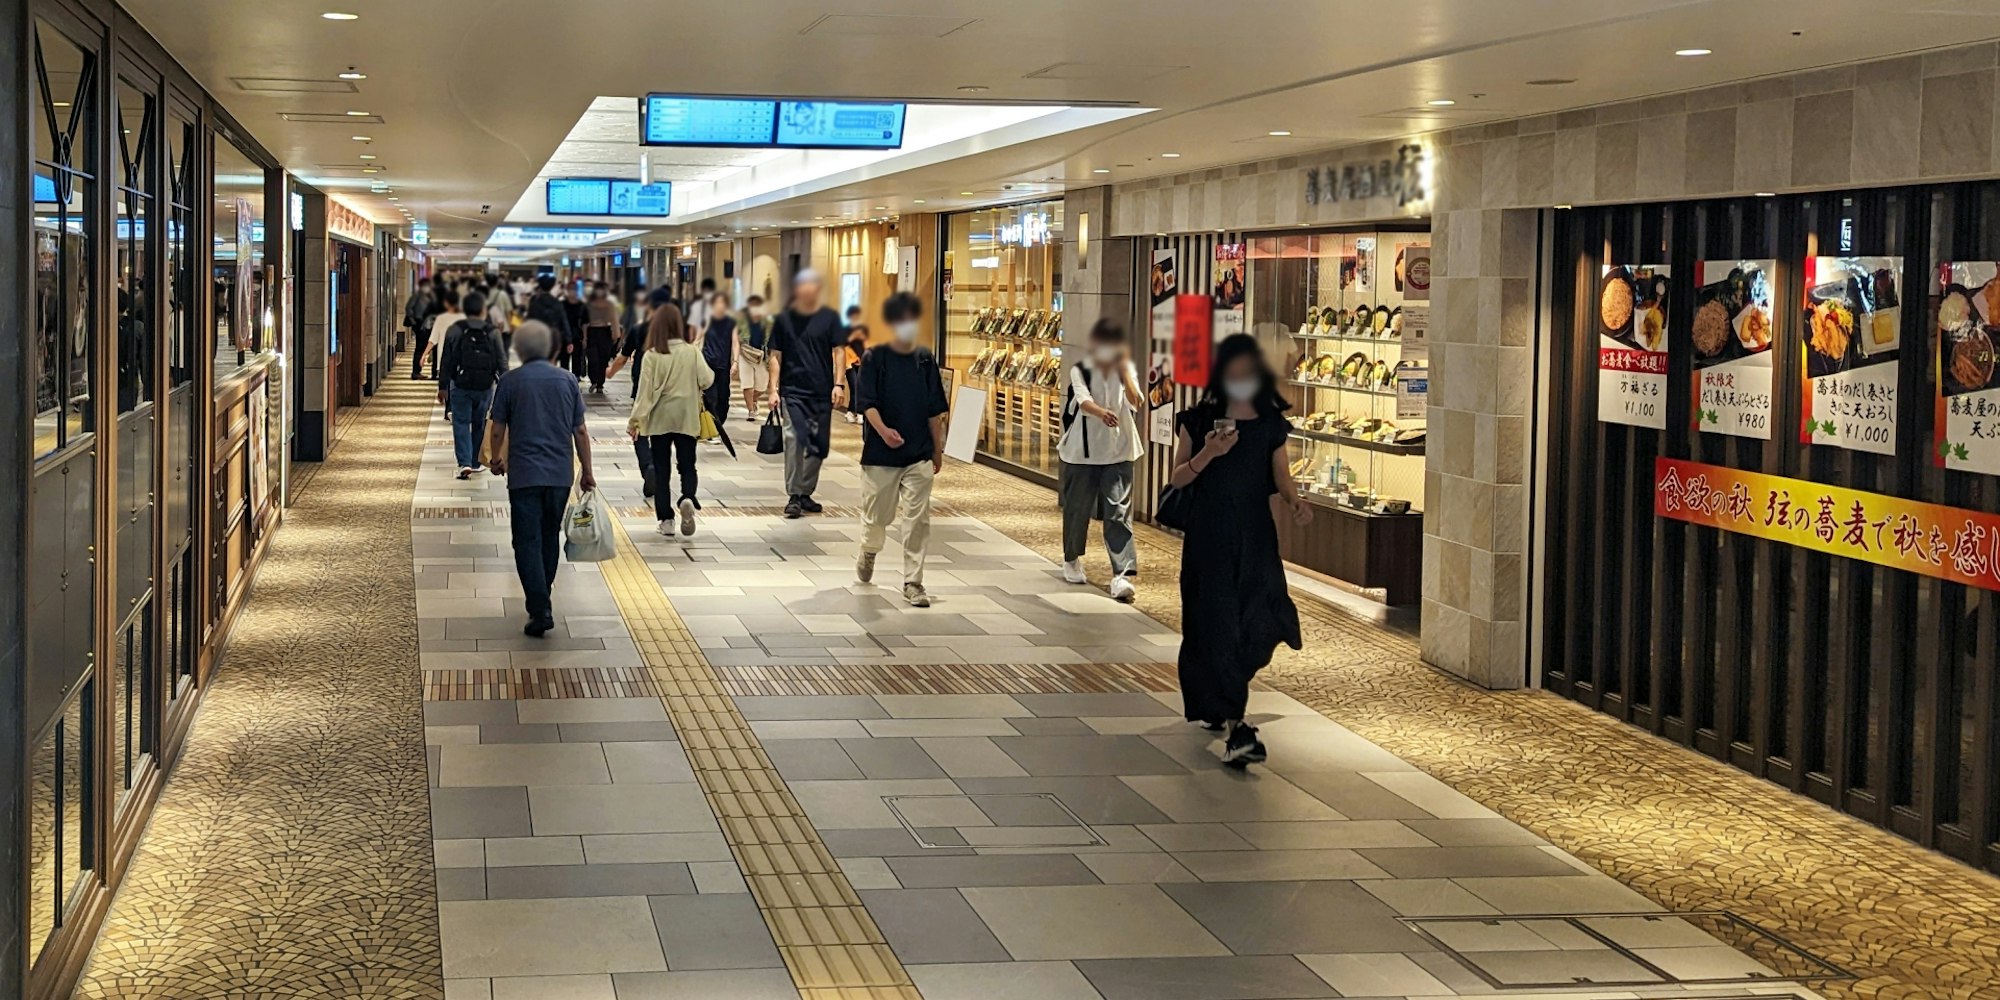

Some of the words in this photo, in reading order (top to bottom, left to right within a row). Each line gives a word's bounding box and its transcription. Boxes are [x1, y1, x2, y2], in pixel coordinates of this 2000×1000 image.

[1705, 371, 1735, 389] 秋限定
[1624, 400, 1655, 417] ¥1,100
[1738, 411, 1766, 429] ¥980
[1845, 422, 1890, 444] ¥1,000
[1657, 466, 1756, 524] 食欲の秋
